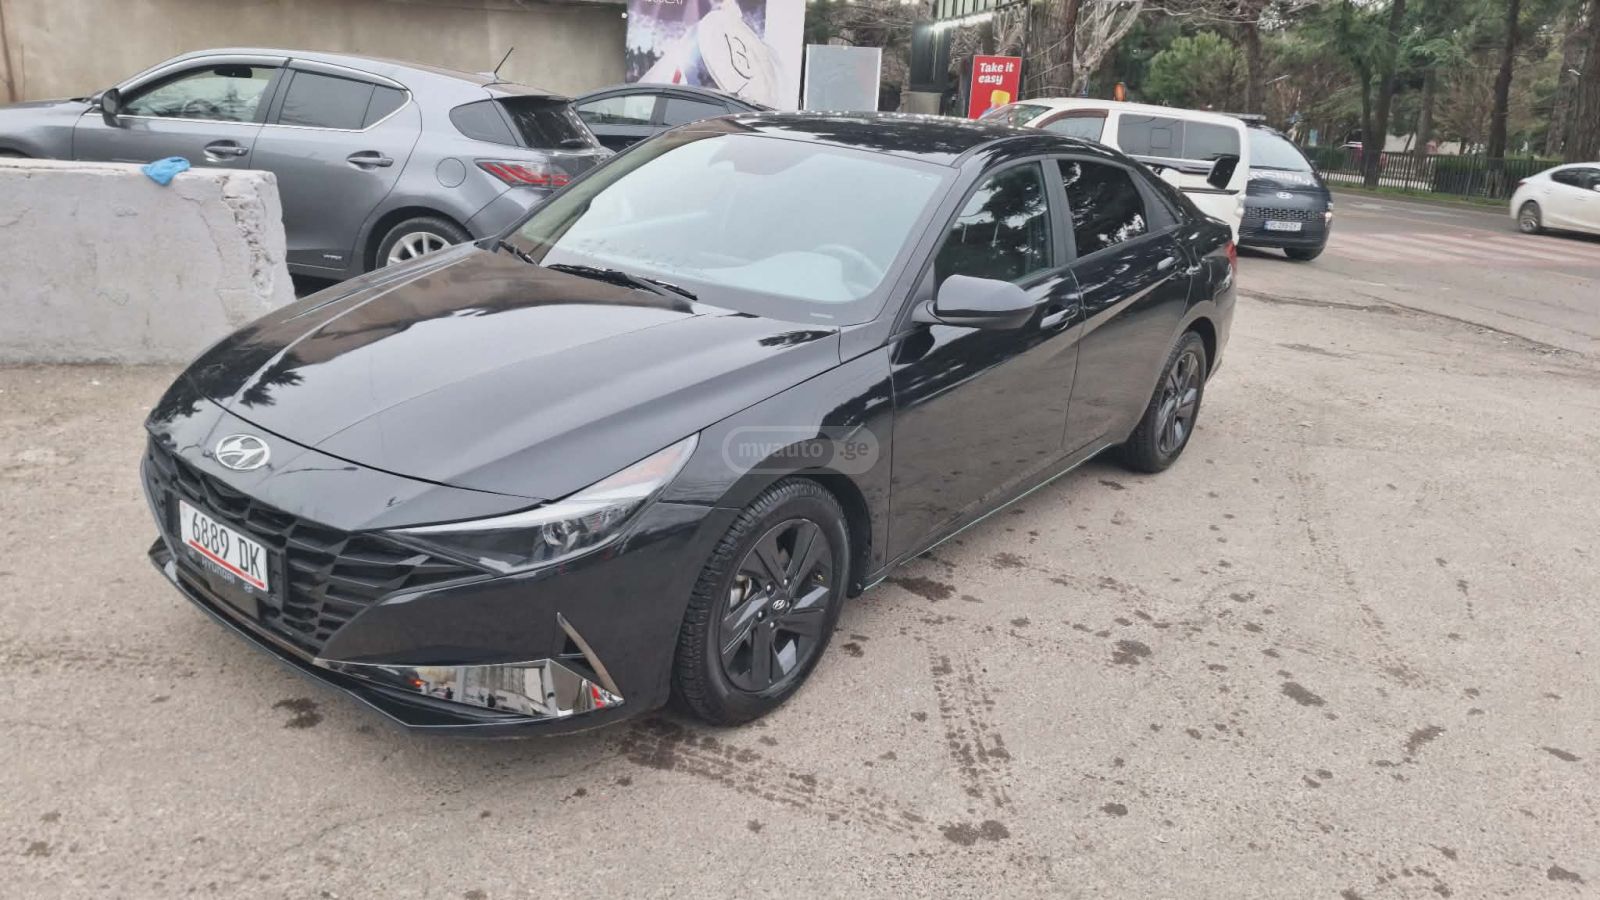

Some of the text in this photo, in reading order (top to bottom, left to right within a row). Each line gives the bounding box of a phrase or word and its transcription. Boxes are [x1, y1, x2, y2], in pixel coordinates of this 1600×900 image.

[980, 62, 1014, 73] Take it
[978, 74, 1003, 86] easy
[192, 512, 262, 580] 6889 DK
